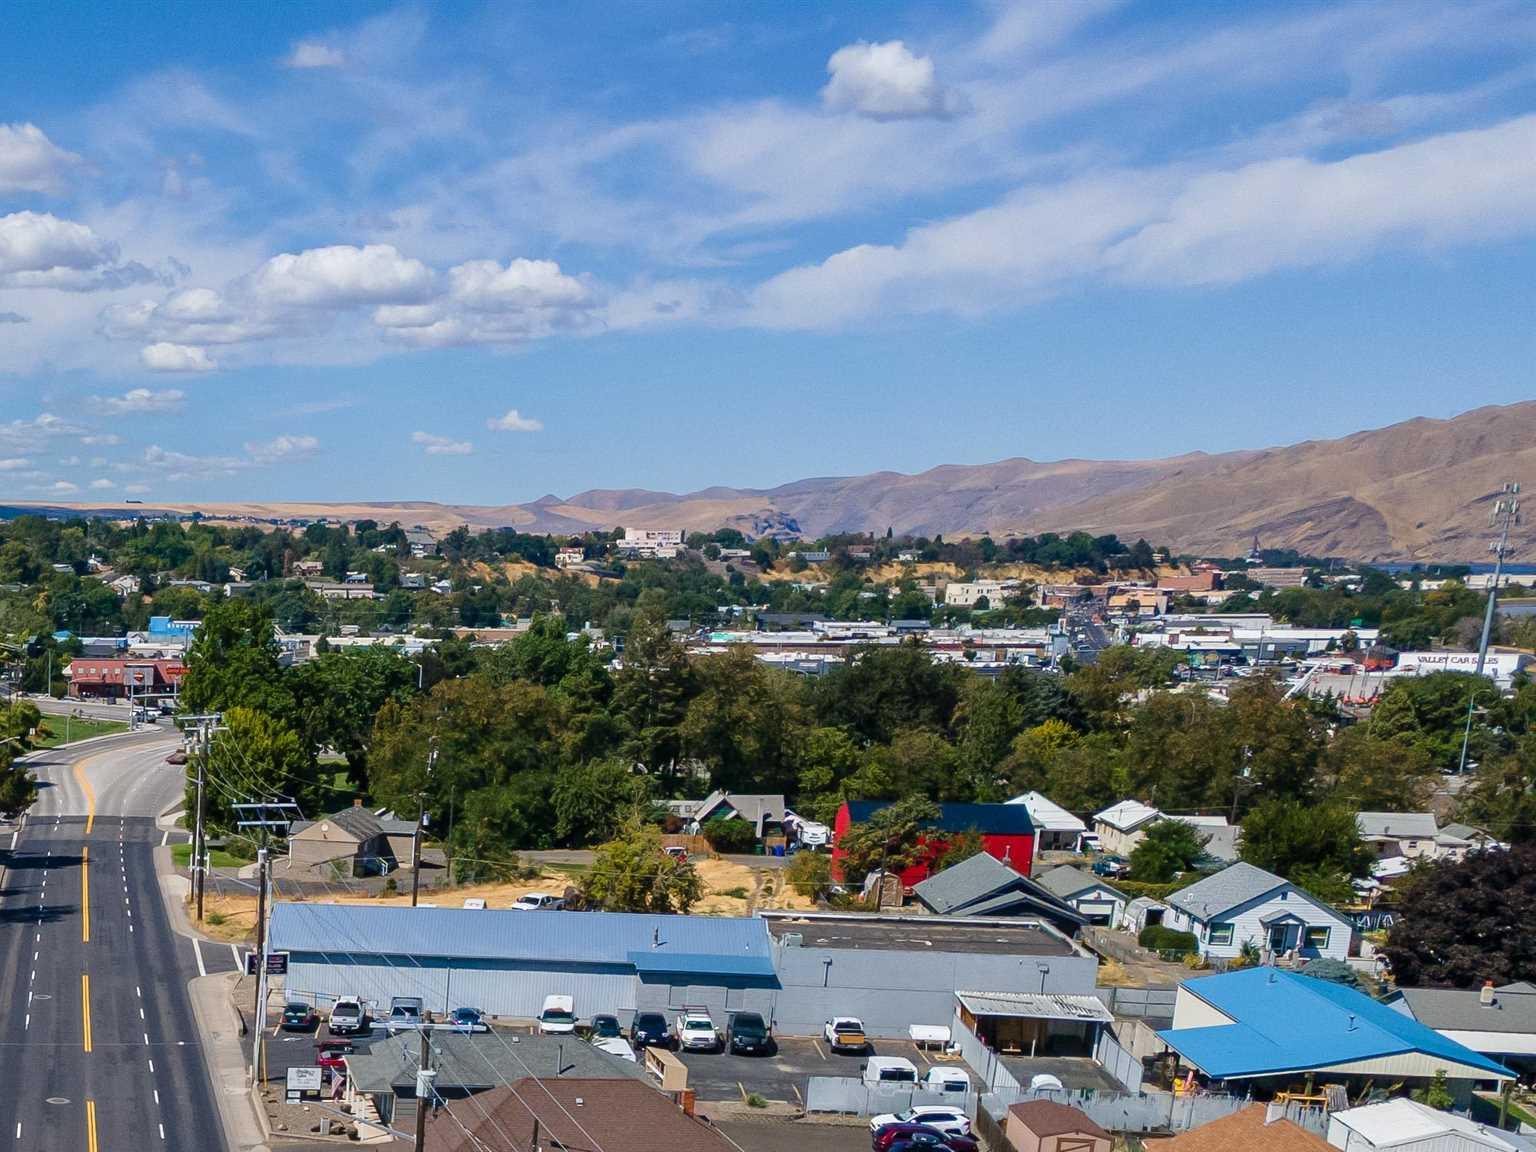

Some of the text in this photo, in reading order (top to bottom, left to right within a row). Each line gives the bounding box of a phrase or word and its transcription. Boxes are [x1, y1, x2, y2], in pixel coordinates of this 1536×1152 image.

[1417, 655, 1499, 665] VALLEY CAR SLES
